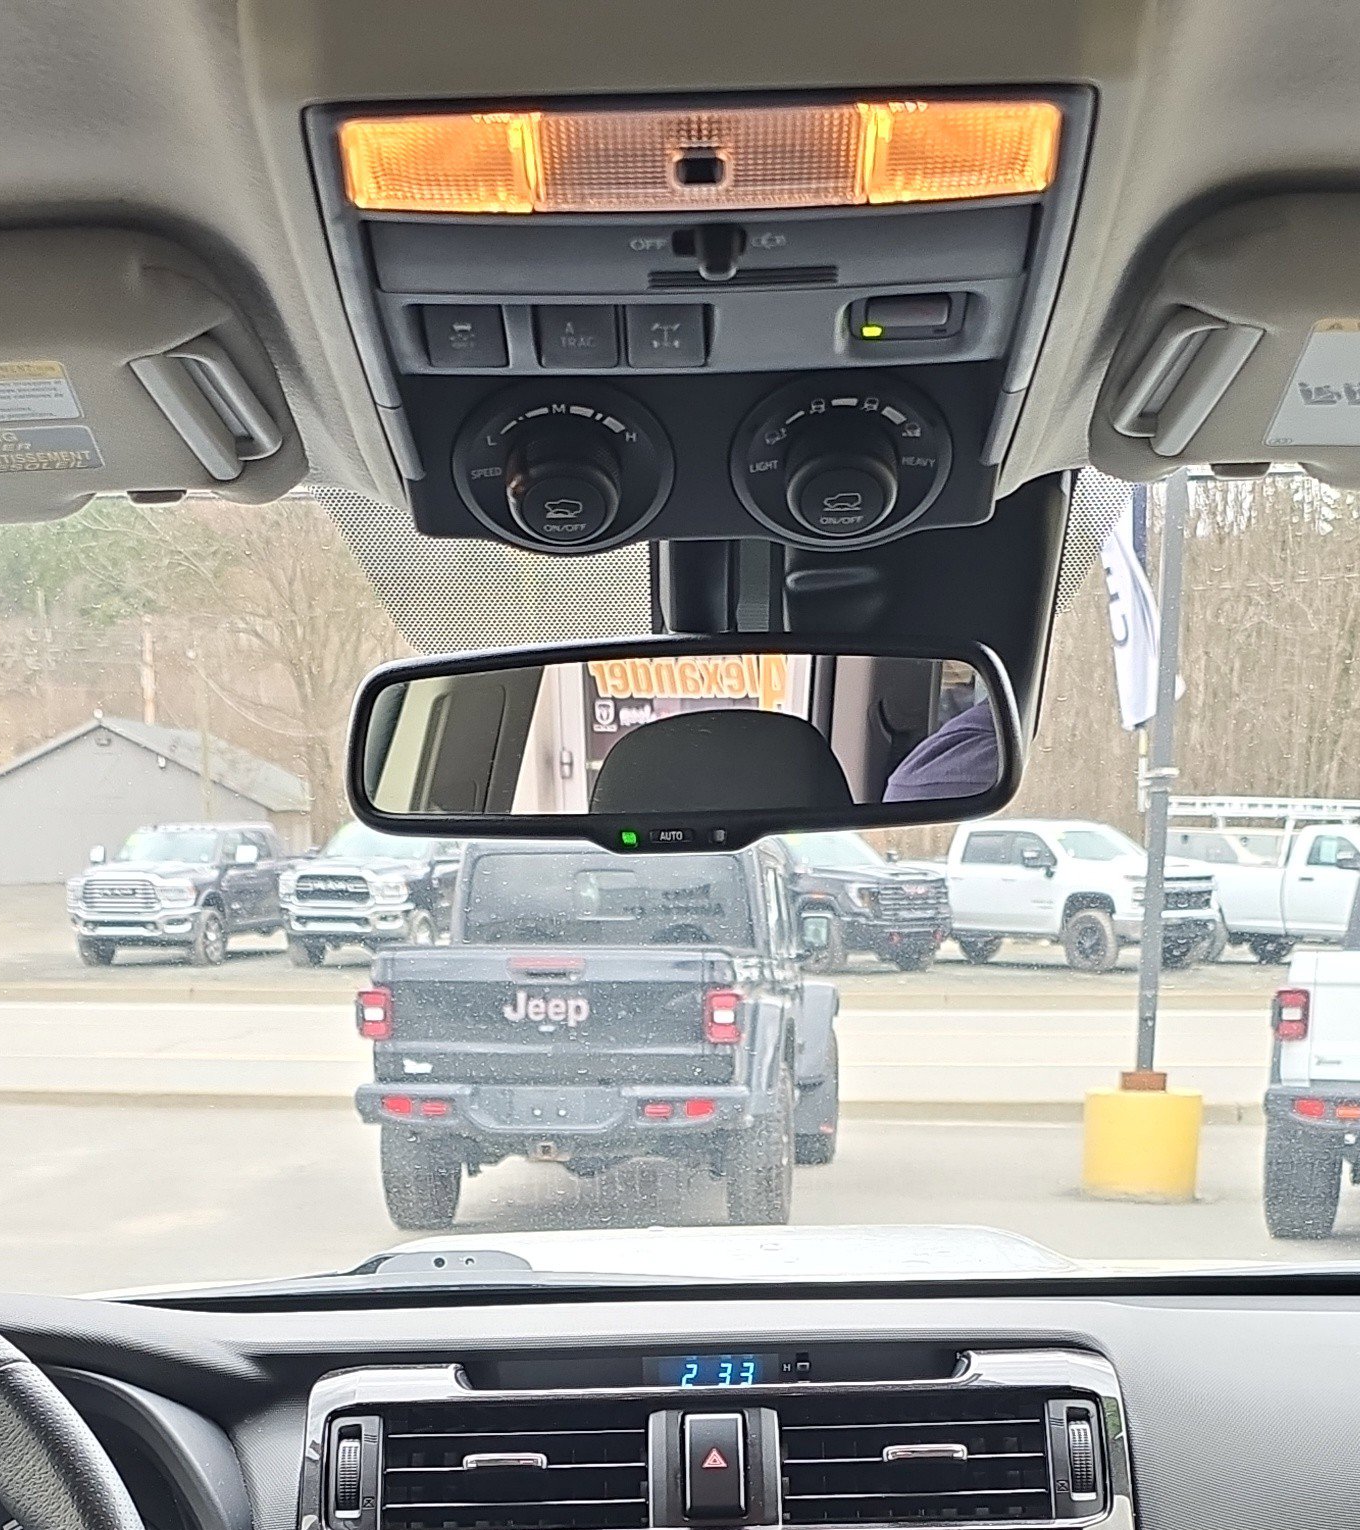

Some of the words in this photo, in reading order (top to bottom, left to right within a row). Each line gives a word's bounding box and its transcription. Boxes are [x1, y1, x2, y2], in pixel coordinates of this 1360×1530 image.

[628, 239, 667, 250] OFF
[565, 322, 574, 333] A
[560, 336, 593, 347] TRAC
[552, 404, 566, 414] M
[487, 435, 497, 446] L
[625, 432, 637, 442] H
[749, 459, 779, 473] LIGHT
[901, 456, 936, 468] HEAVY
[470, 466, 502, 479] SPEED
[820, 515, 864, 525] ON/OFF
[543, 523, 586, 532] ON/OFF
[659, 831, 683, 841] AUTO
[503, 991, 590, 1026] Jeep
[782, 1363, 791, 1371] H
